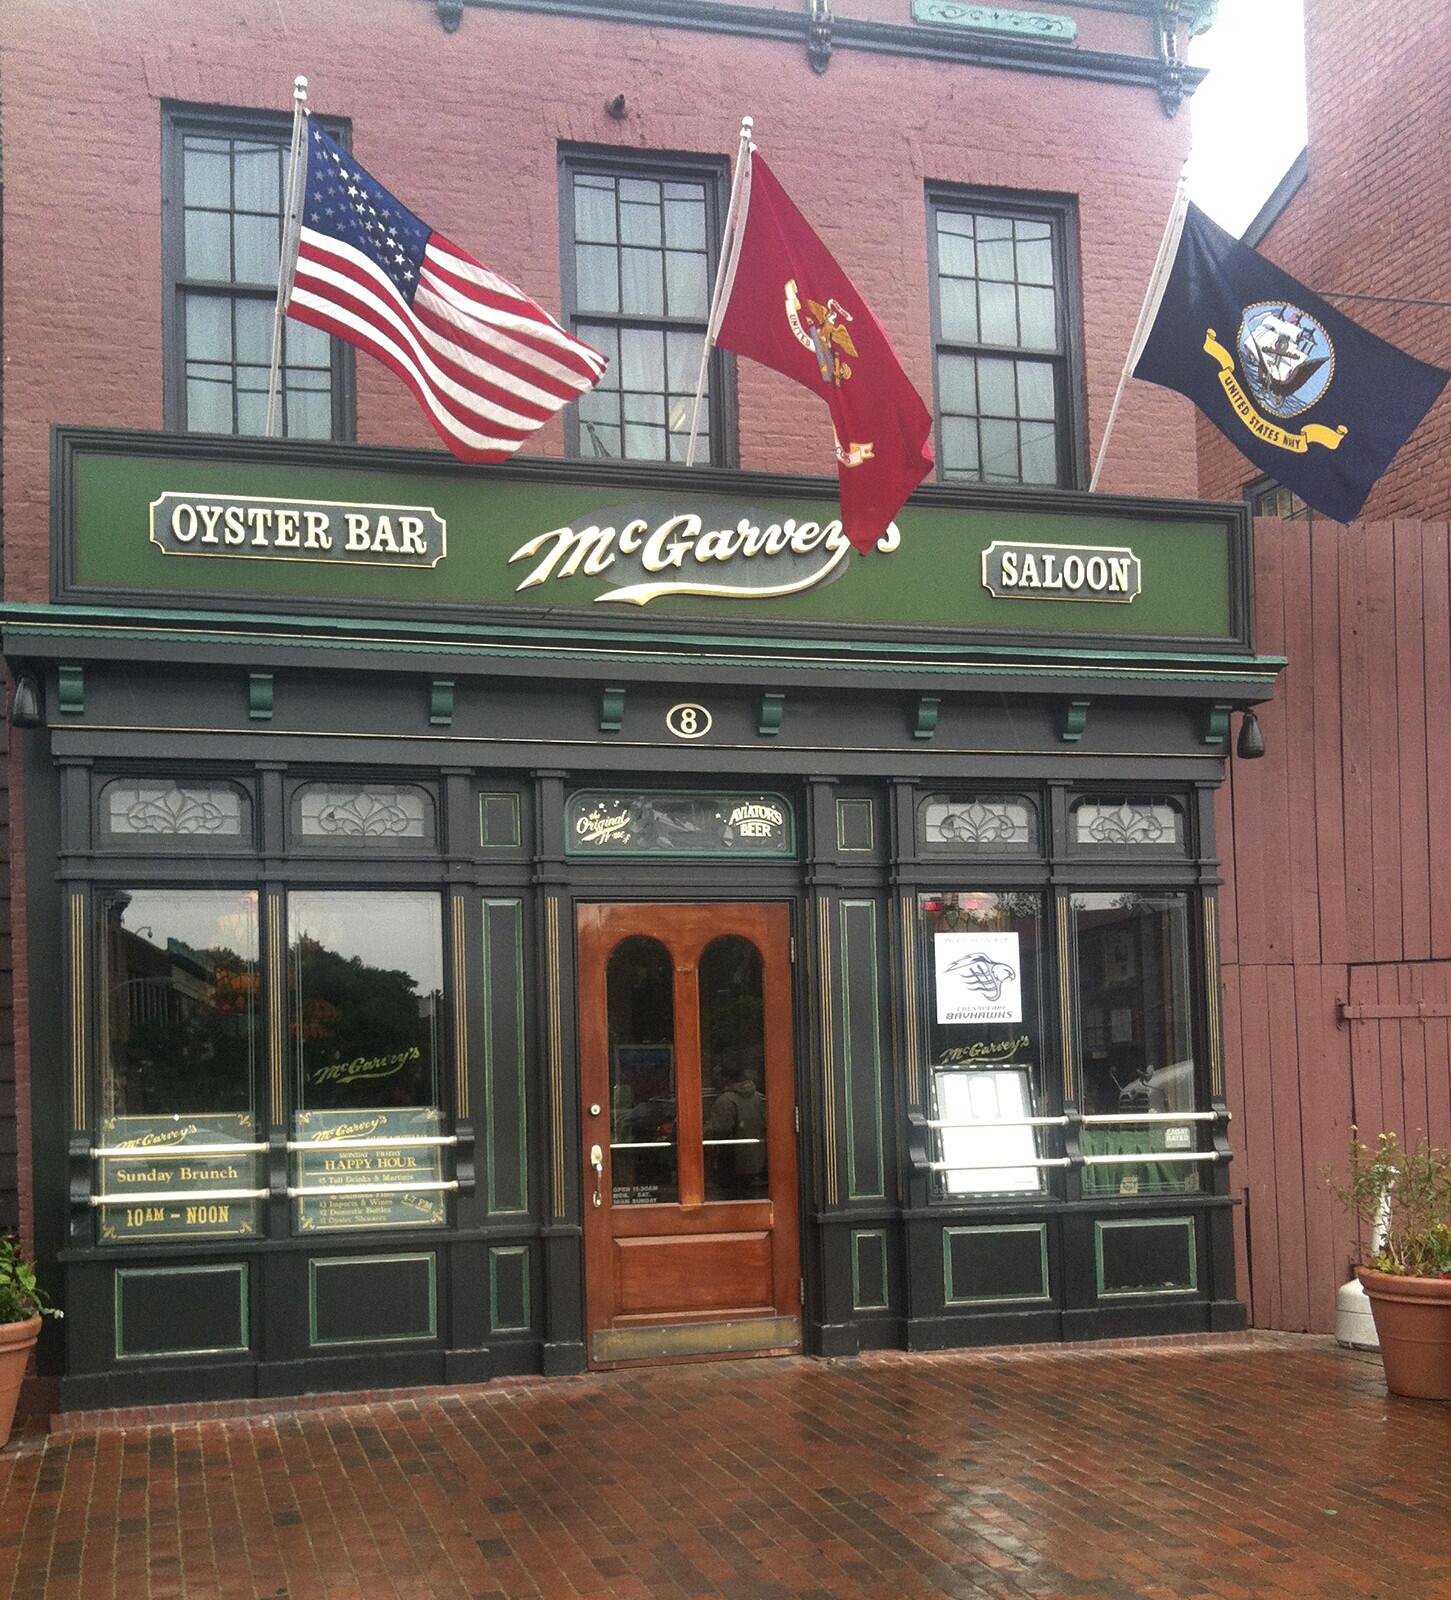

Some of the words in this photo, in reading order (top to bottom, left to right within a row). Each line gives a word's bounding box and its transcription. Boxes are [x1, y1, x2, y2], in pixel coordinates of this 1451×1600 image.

[788, 313, 811, 347] UNITED
[1224, 376, 1250, 416] UNITED
[1250, 415, 1280, 441] STATES
[171, 503, 333, 549] OYSTER
[344, 513, 427, 554] BAR
[508, 513, 900, 605] McGarveys
[1001, 551, 1131, 592] SALOON
[680, 708, 697, 734] 8
[576, 810, 631, 835] Original
[740, 822, 772, 837] BEER
[945, 1010, 1014, 1020] BAYHAWKS
[939, 1035, 1031, 1065] McGarvey's
[311, 1115, 388, 1142] McGarvey's
[116, 1167, 174, 1184] Sunday
[180, 1165, 239, 1181] Brunch
[325, 1158, 373, 1171] HAPPY
[377, 1156, 417, 1169] HOUR
[186, 1205, 230, 1225] NOON
